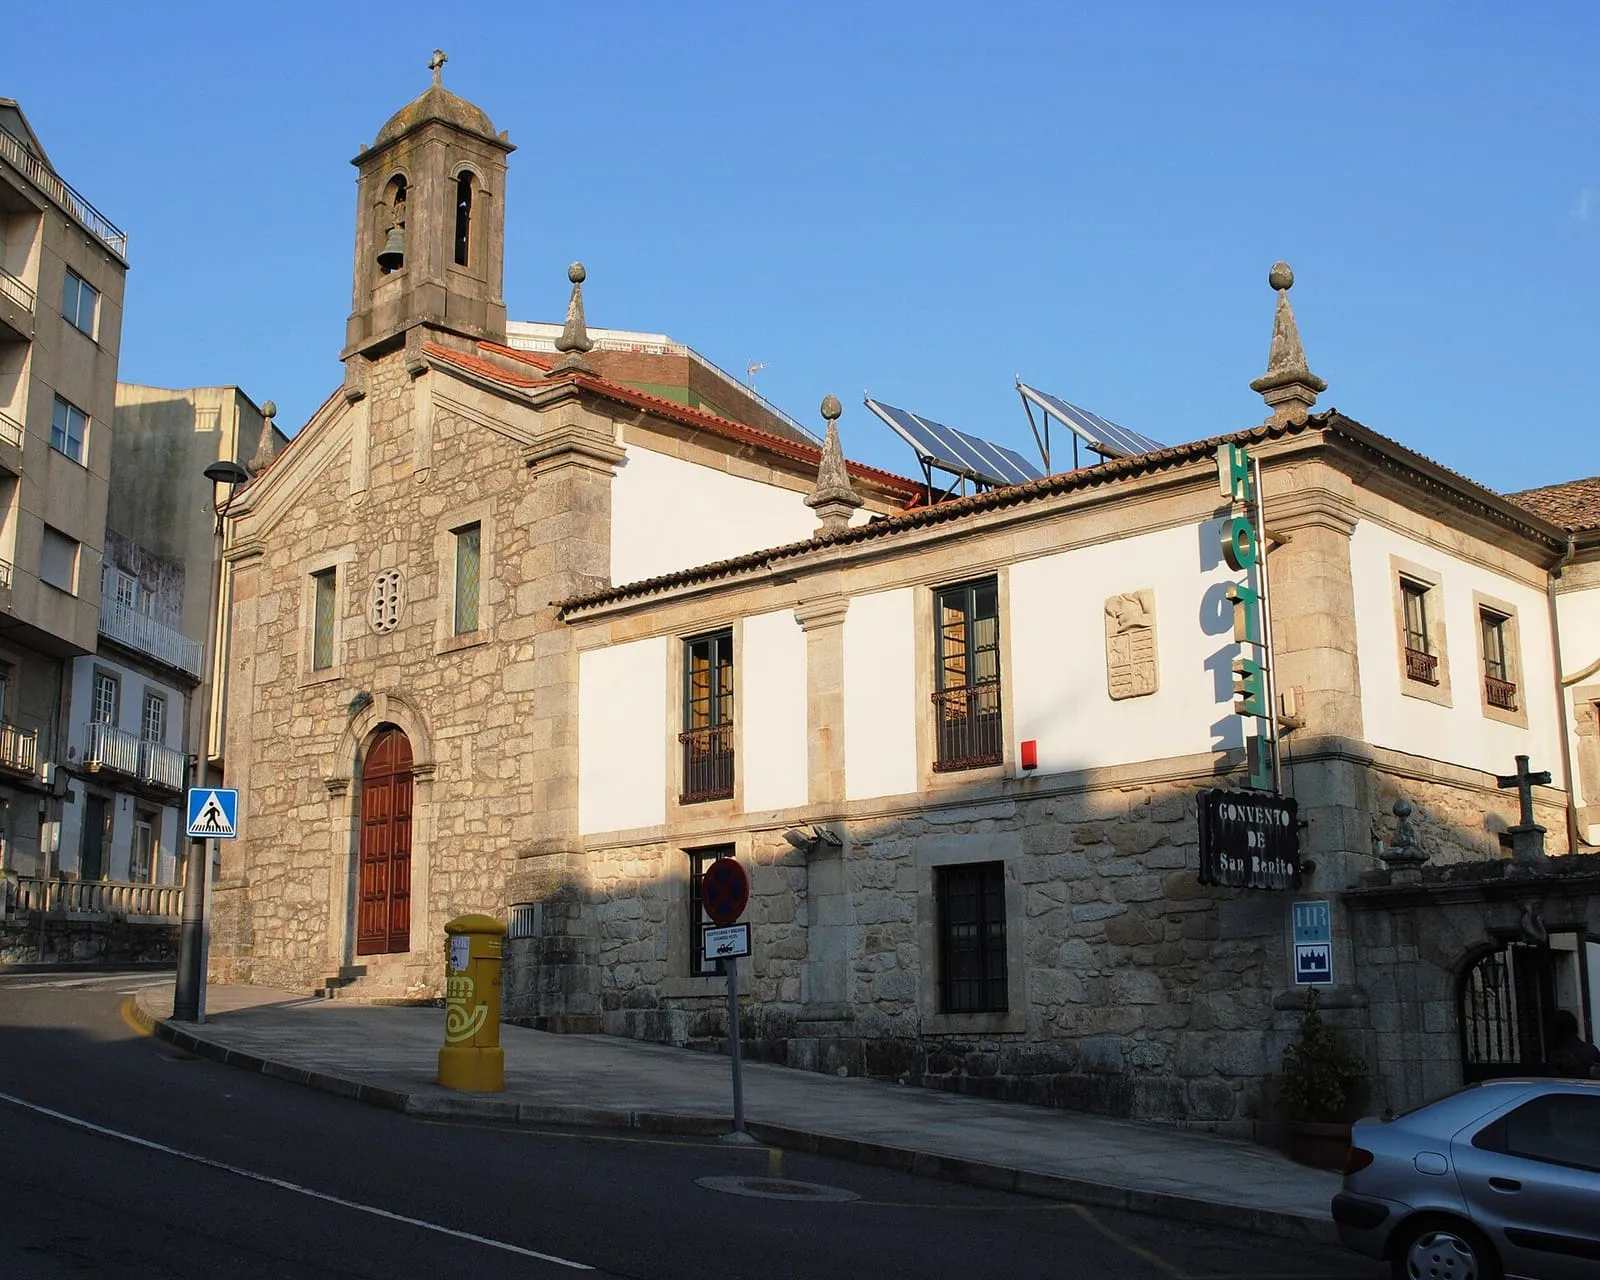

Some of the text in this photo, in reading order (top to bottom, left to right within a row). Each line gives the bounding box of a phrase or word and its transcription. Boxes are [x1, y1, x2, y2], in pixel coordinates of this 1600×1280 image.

[1217, 442, 1268, 790] HOTEL
[1219, 802, 1290, 827] CONVENTO
[1247, 830, 1266, 849] DE
[1220, 853, 1294, 876] San Benito
